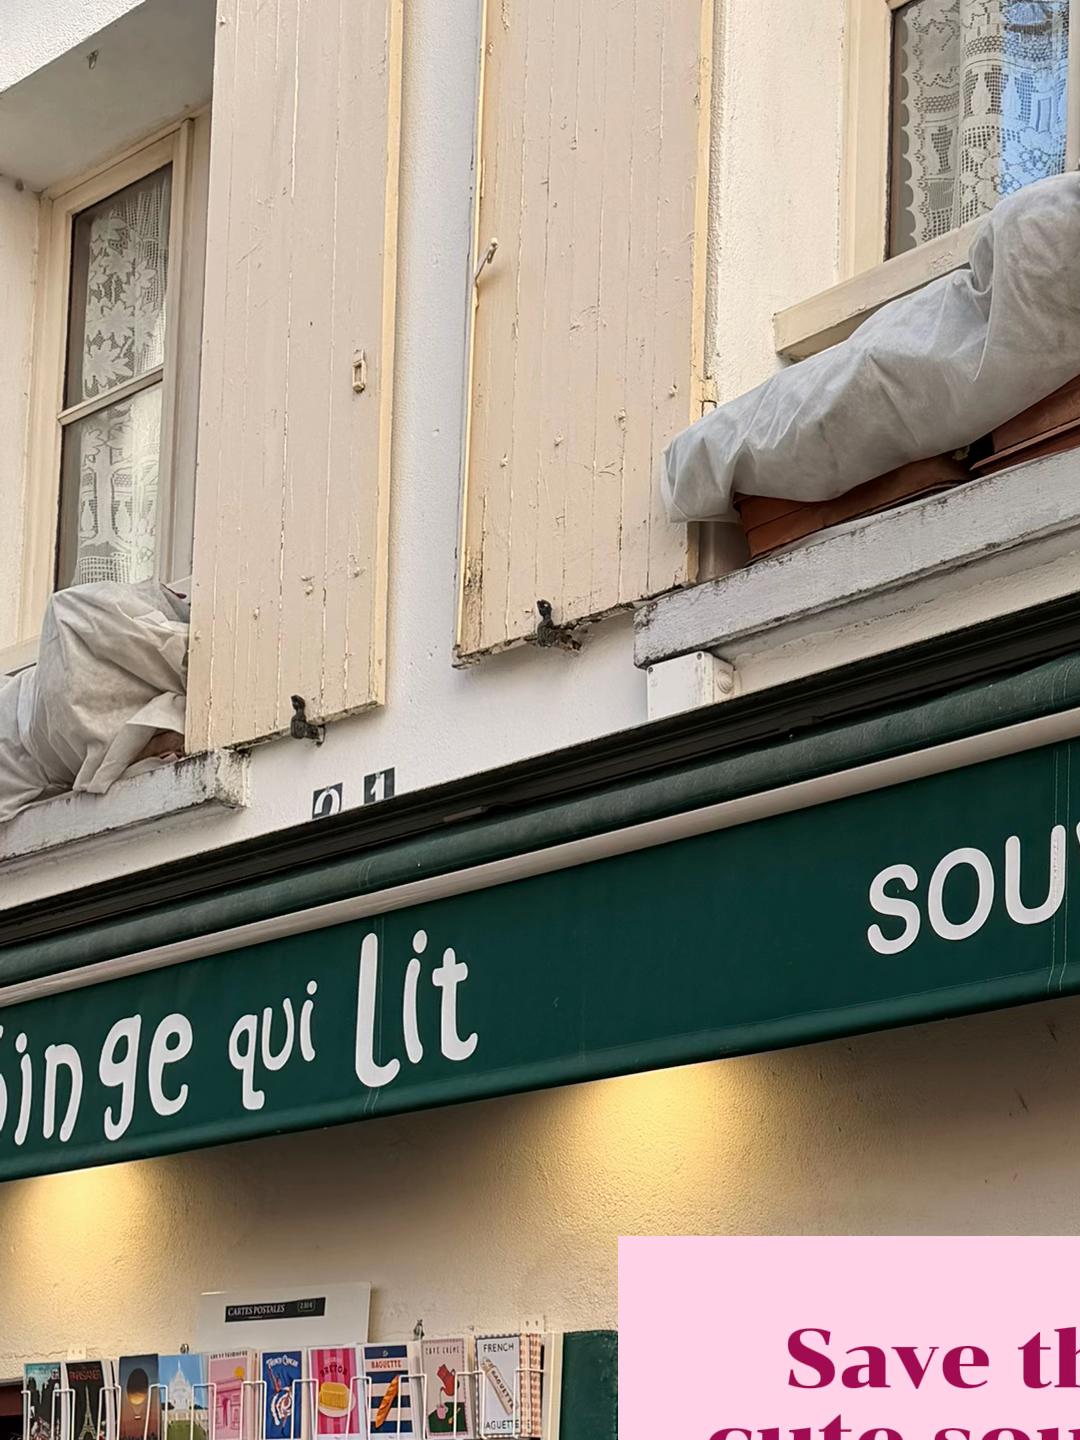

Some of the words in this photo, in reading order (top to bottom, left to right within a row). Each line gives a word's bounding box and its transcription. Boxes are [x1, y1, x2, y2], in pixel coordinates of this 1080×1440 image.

[0, 1013, 194, 1146] inge
[228, 980, 318, 1110] qui
[354, 929, 479, 1088] Lit
[228, 1305, 252, 1316] CARTES
[253, 1303, 285, 1315] POSTALES
[483, 1343, 514, 1352] FRENCH
[371, 1359, 402, 1369] BAGUETTE
[483, 1420, 519, 1430] AGUETTE
